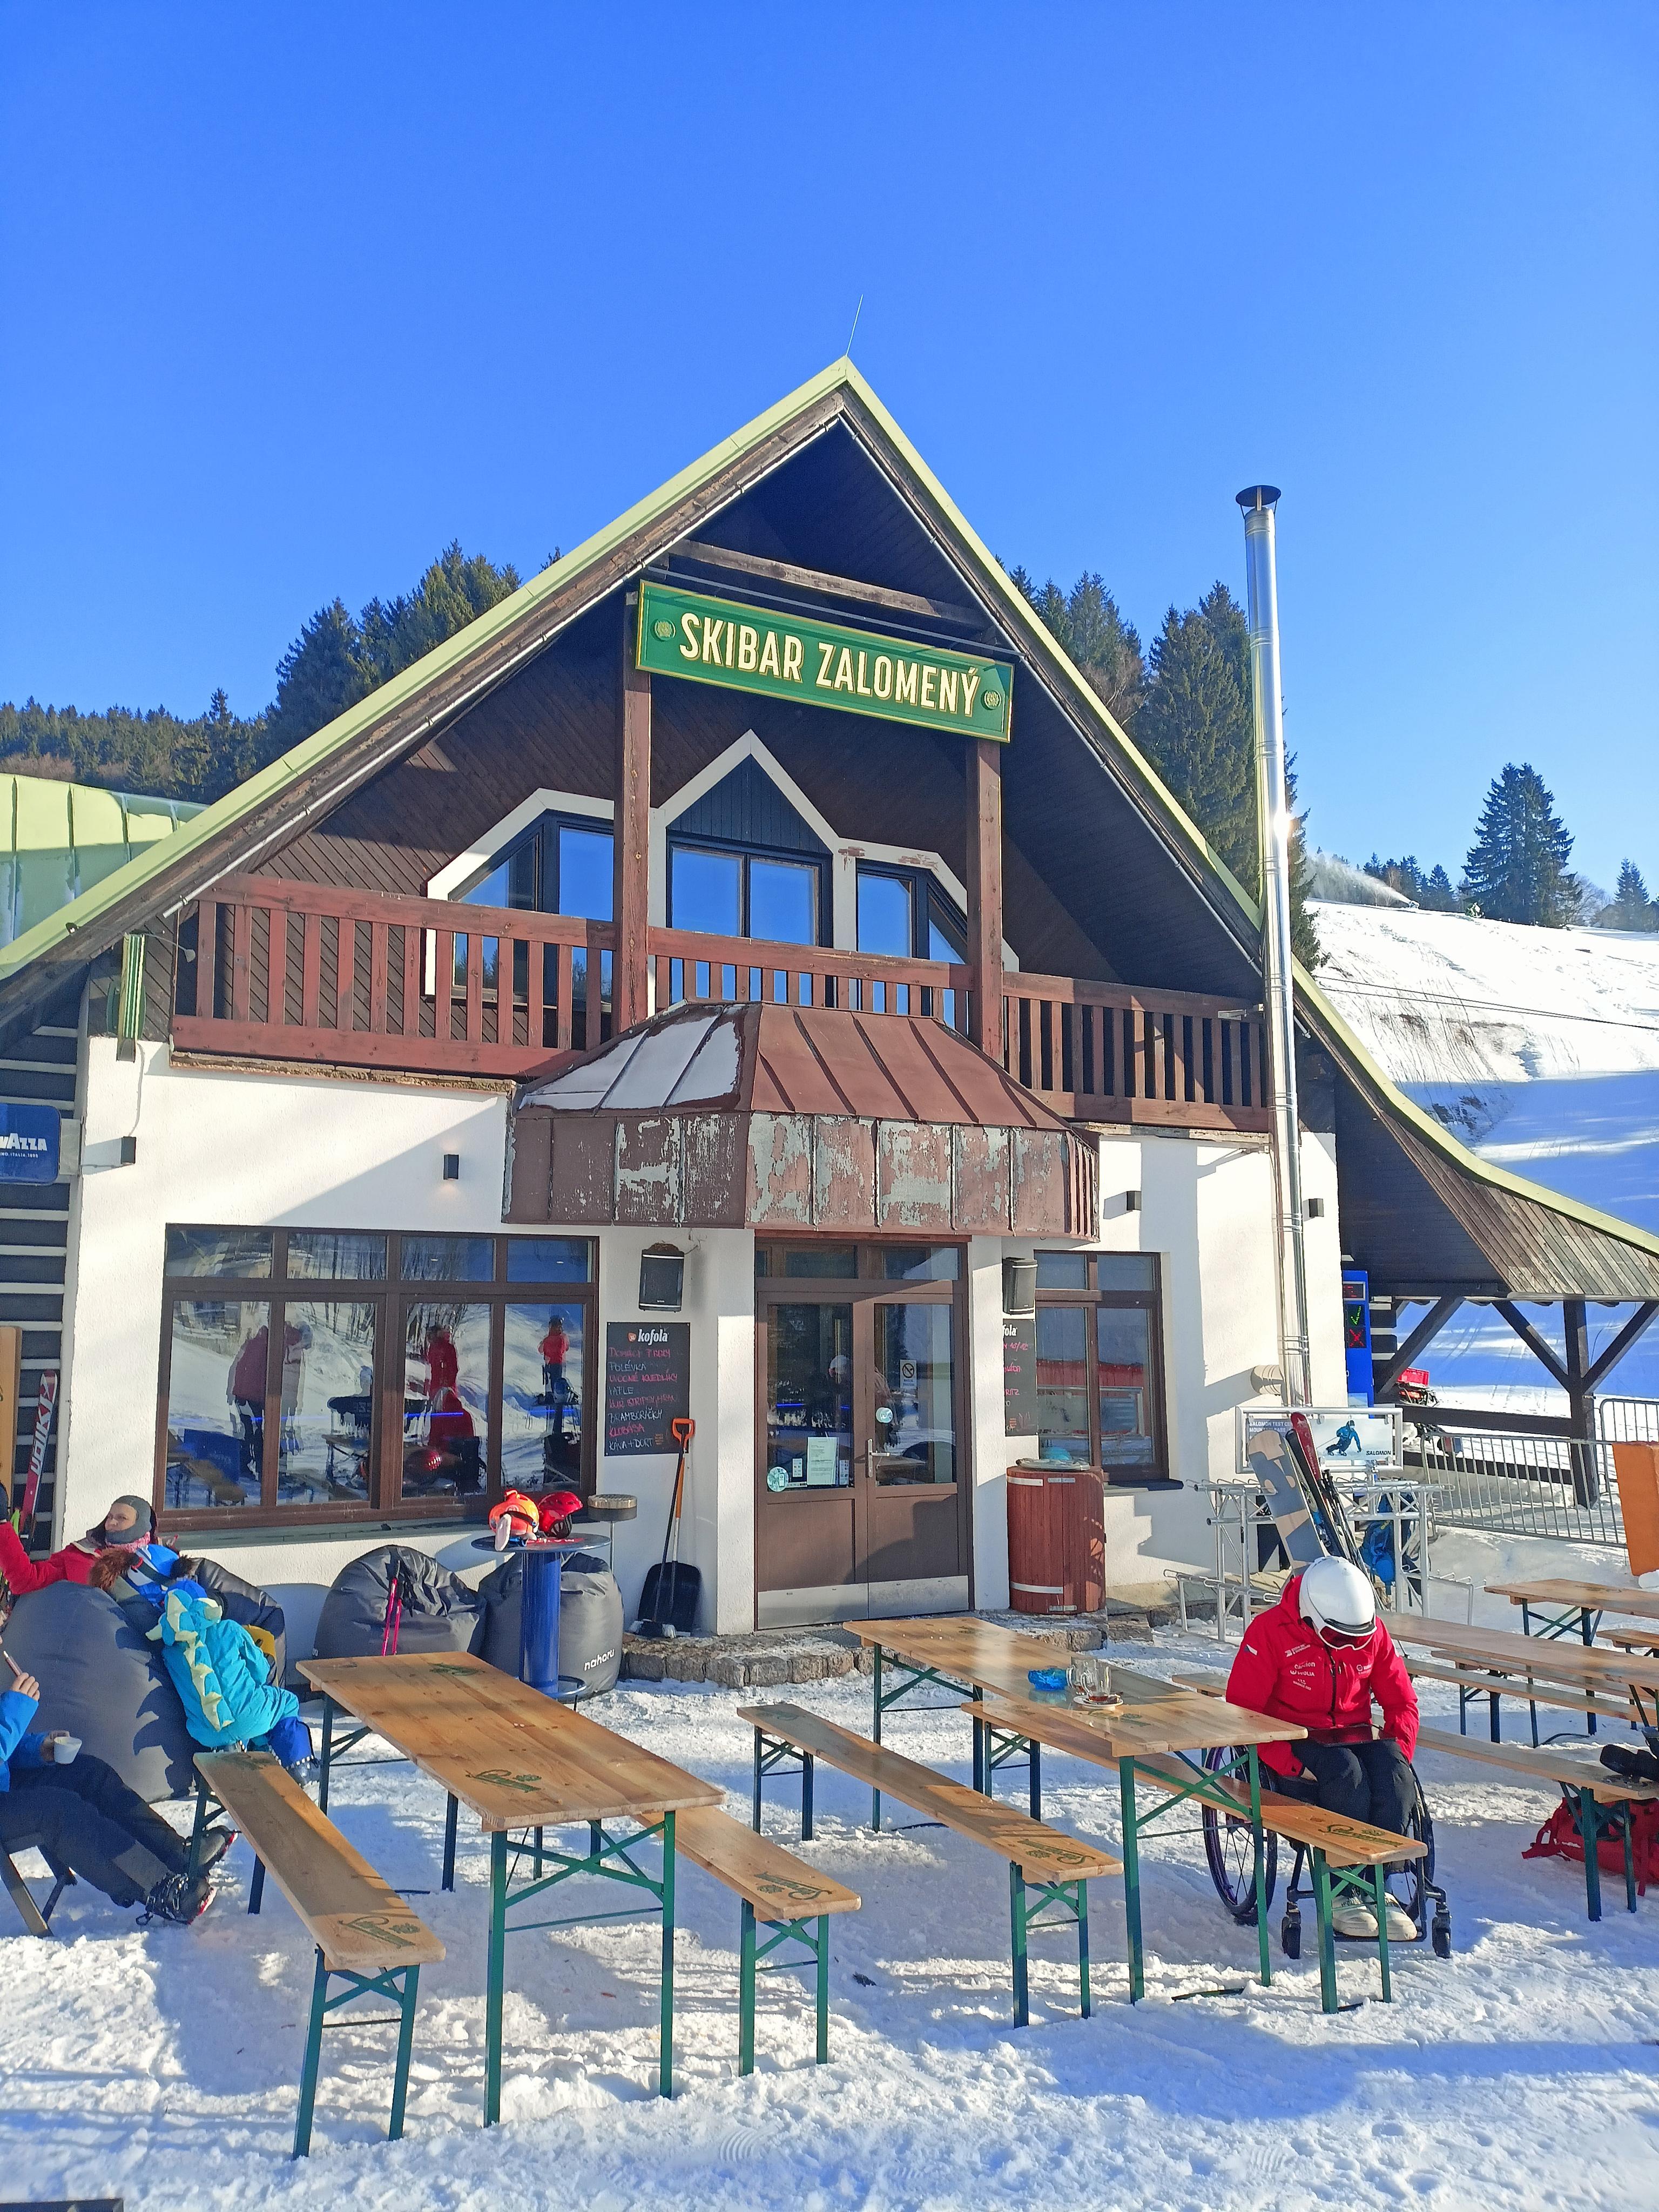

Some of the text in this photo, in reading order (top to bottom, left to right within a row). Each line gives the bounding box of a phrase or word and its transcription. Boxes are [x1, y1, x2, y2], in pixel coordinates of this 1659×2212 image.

[679, 612, 981, 717] SKIBAR ZALOMENÝ
[0, 1132, 48, 1151] VAZZA
[637, 1328, 668, 1346] kofola
[1003, 1324, 1017, 1336] fola
[608, 1359, 646, 1372] POLÉVKA
[609, 1421, 645, 1437] KLOBÁSA
[584, 1649, 615, 1671] nahoru
